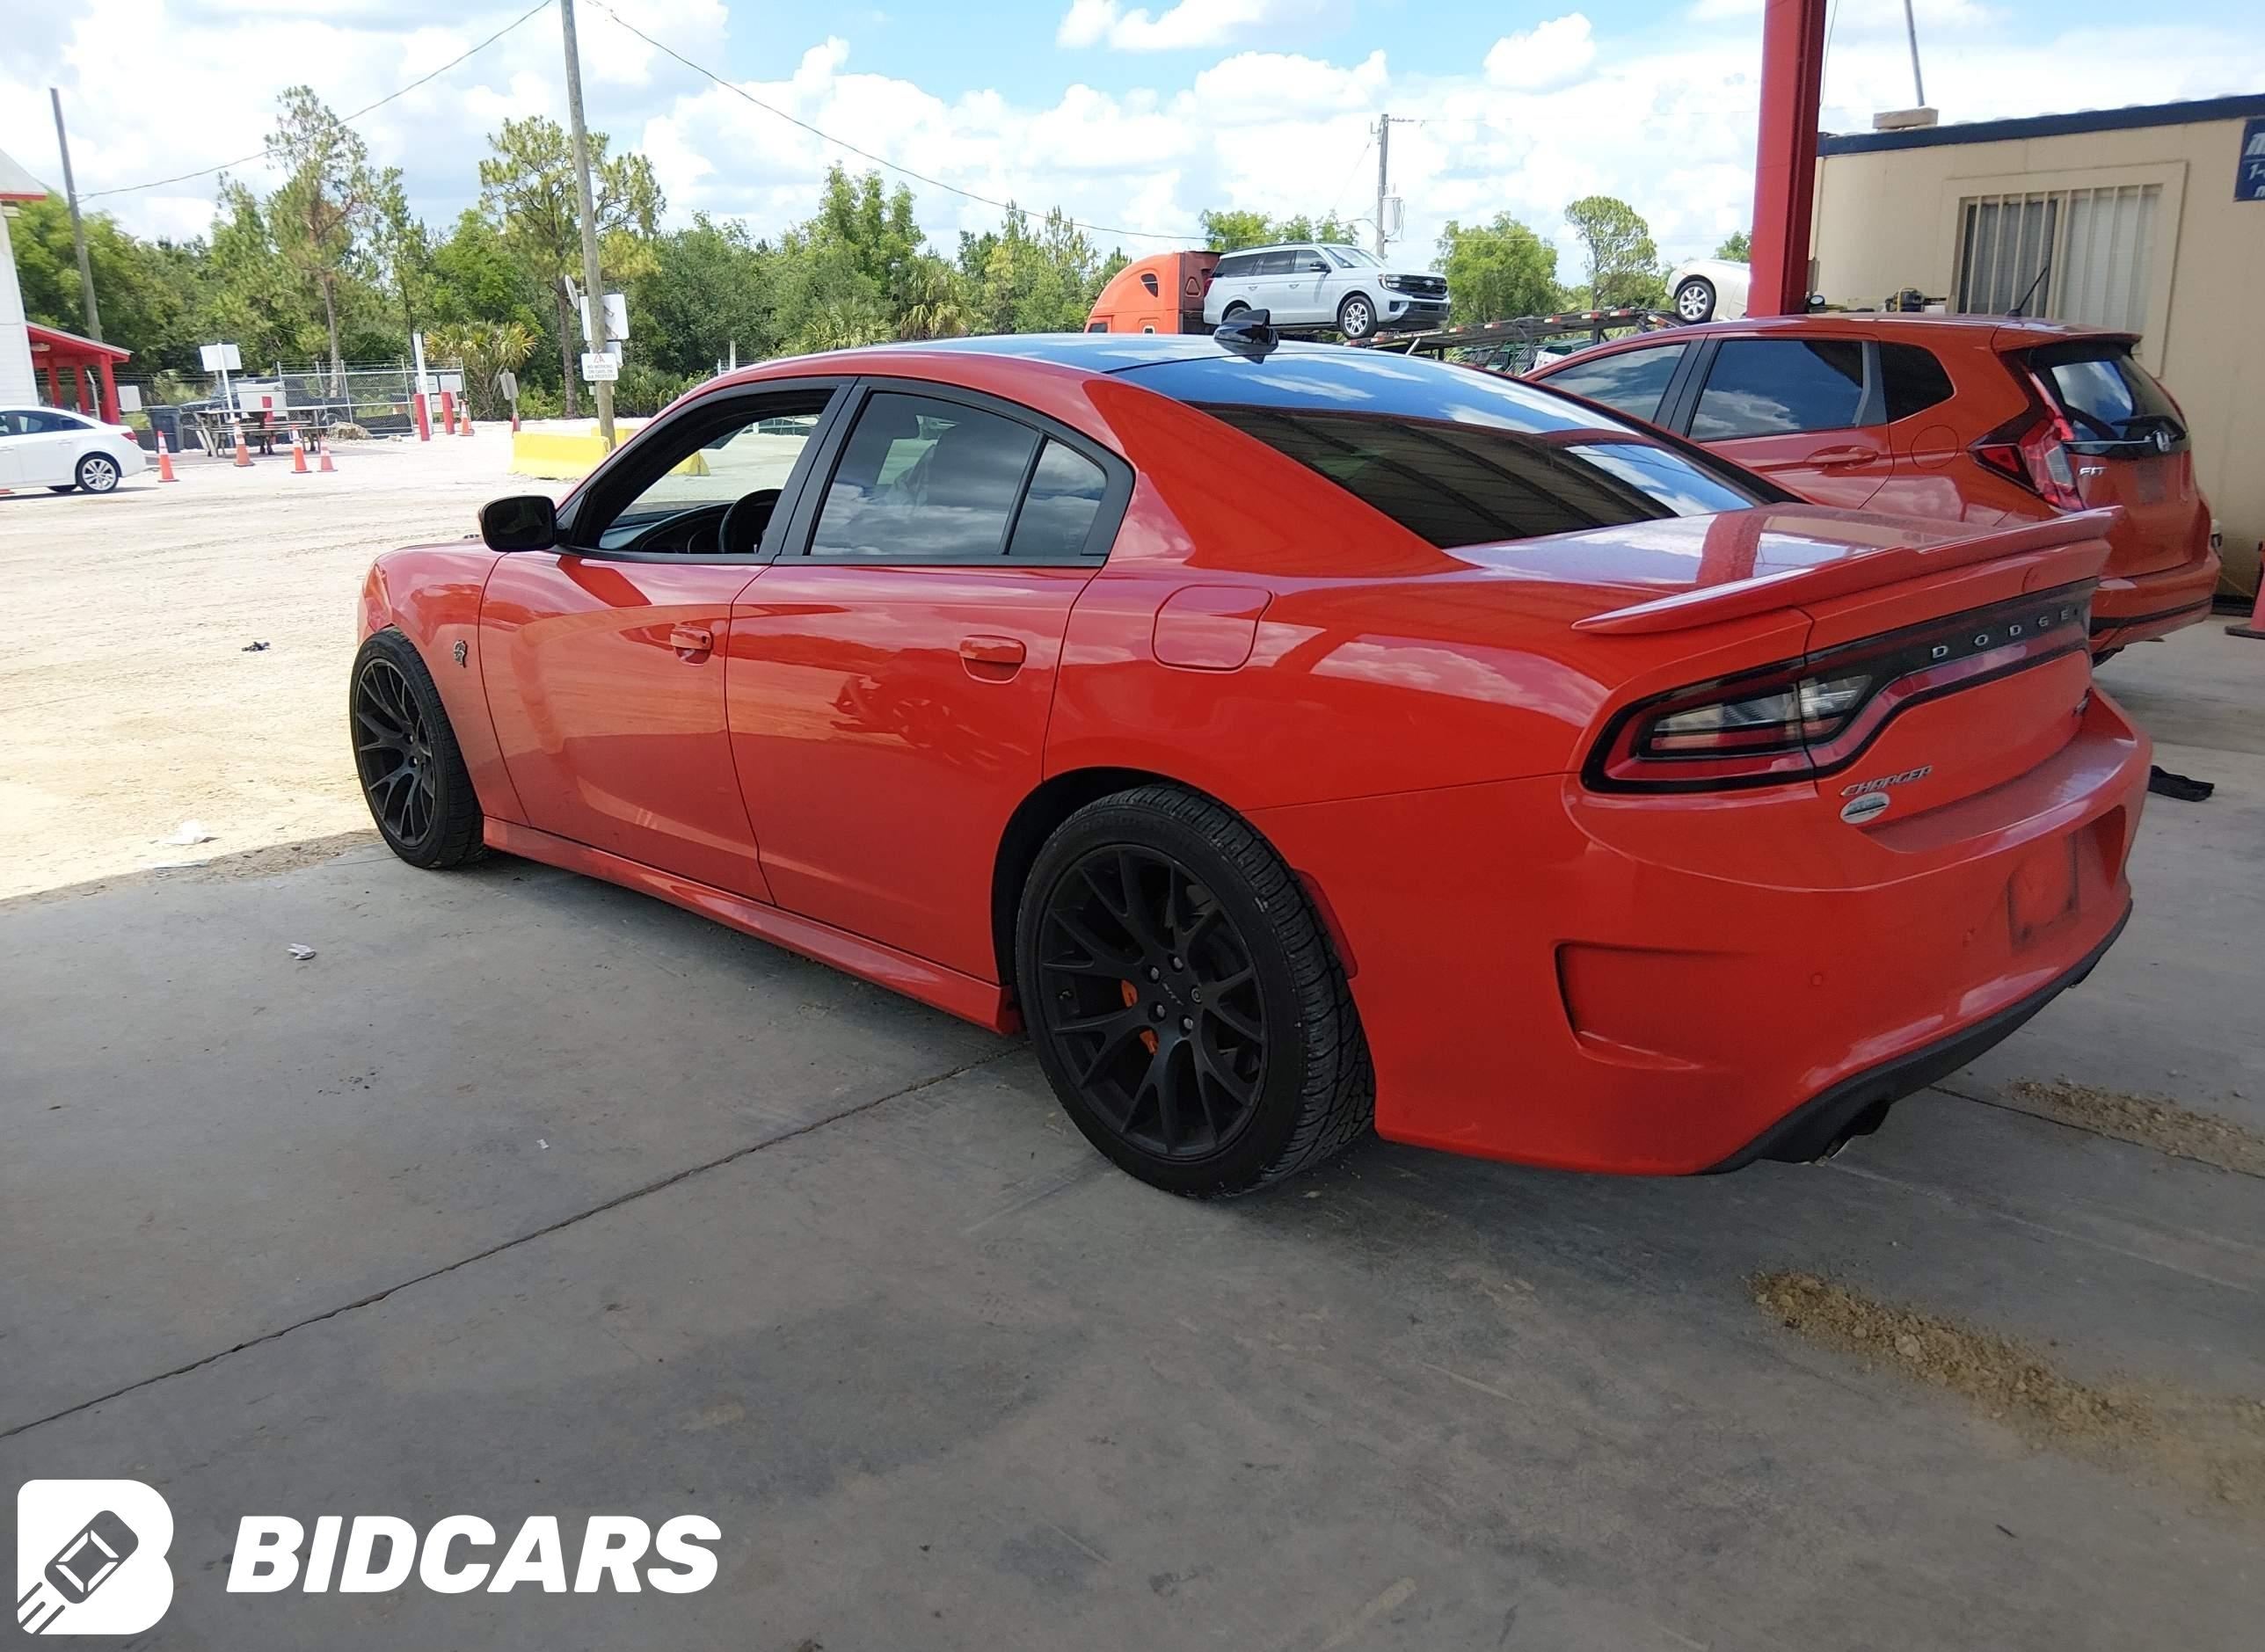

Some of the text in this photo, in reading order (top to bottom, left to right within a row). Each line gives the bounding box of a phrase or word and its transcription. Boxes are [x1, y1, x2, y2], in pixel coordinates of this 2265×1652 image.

[2079, 467, 2108, 477] FIT
[1932, 608, 2069, 659] DODGE
[1840, 765, 1933, 797] CHARGER
